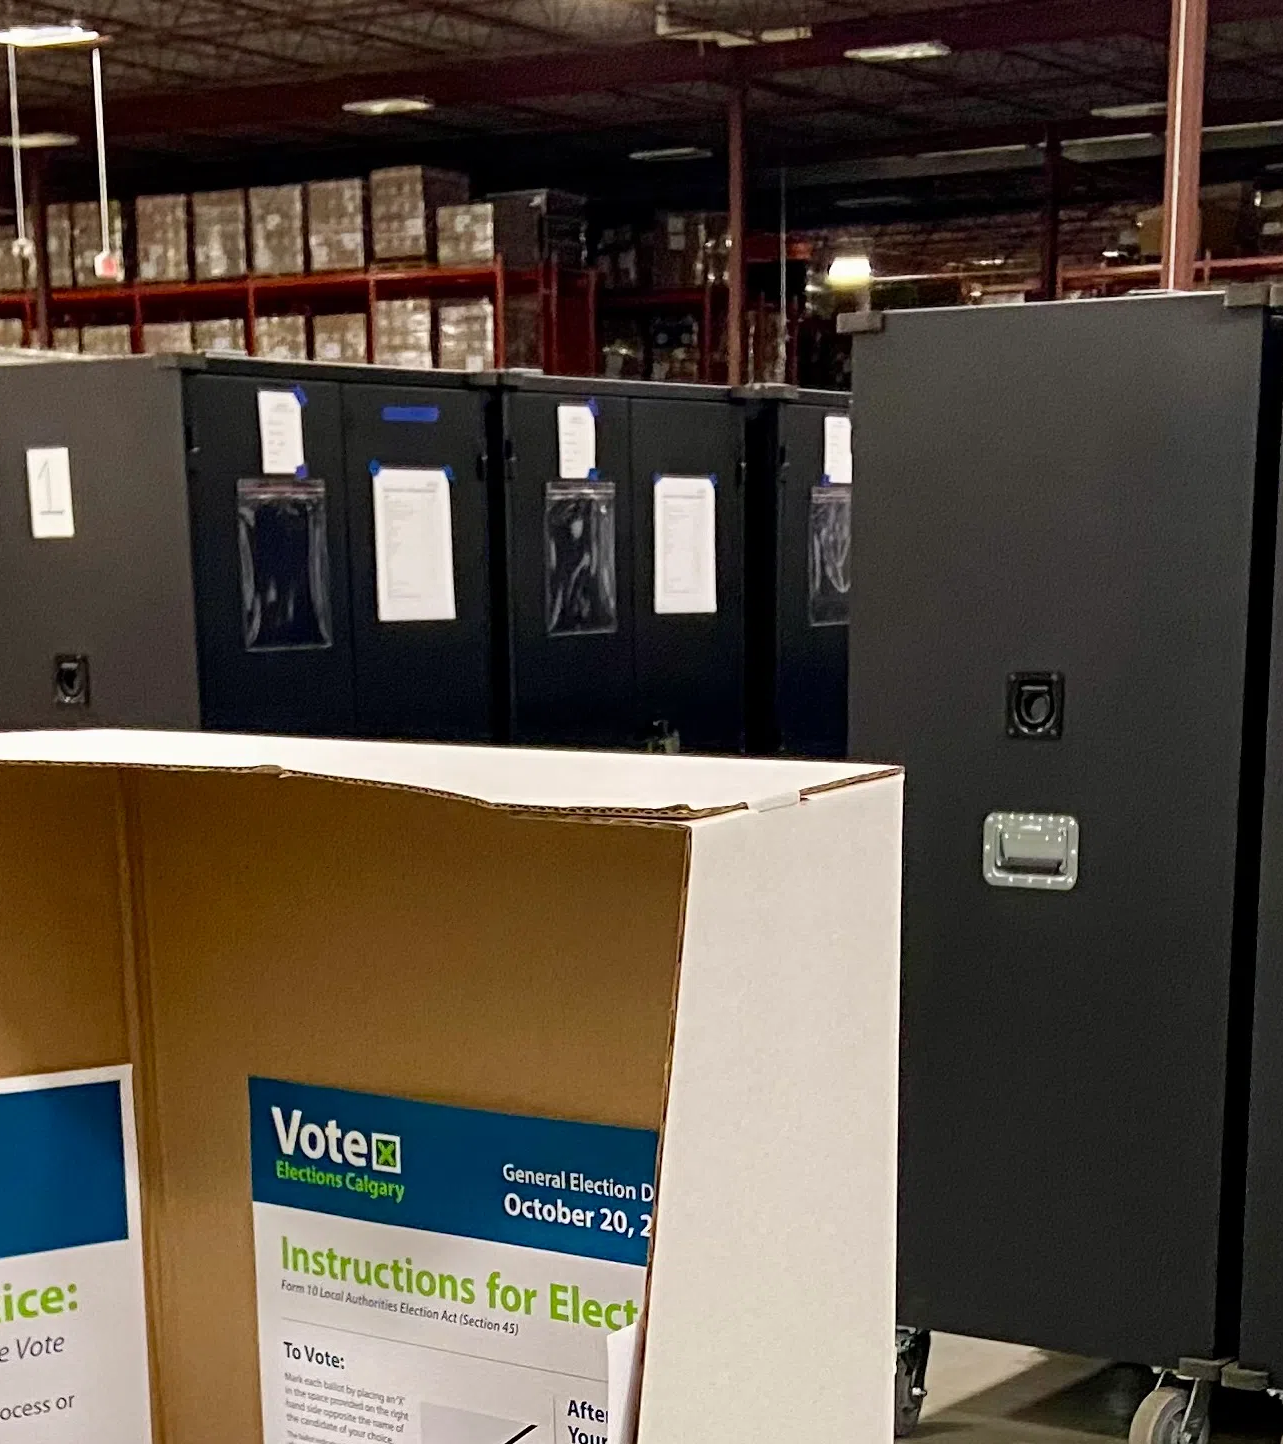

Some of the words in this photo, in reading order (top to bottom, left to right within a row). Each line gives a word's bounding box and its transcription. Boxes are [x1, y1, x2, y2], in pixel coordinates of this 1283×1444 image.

[270, 1106, 368, 1166] Vote
[275, 1160, 347, 1188] Elections
[344, 1172, 405, 1203] Calgary
[501, 1163, 566, 1189] General
[568, 1172, 637, 1200] Election
[640, 1183, 653, 1202] D
[503, 1192, 595, 1227] October
[598, 1208, 635, 1238] 20,
[639, 1214, 651, 1237] 2
[281, 1236, 476, 1304] Instructions
[485, 1271, 538, 1314] for
[549, 1283, 638, 1331] Elect
[281, 1280, 305, 1293] Form
[307, 1284, 318, 1297] 10
[320, 1286, 344, 1302] Local
[345, 1292, 398, 1313] Authorities
[400, 1302, 439, 1320] Election
[441, 1310, 458, 1324] Act
[459, 1313, 500, 1334] (Section
[500, 1321, 520, 1337] 45)
[15, 1335, 65, 1360] Vote
[282, 1341, 302, 1359] To
[302, 1345, 345, 1369] Vote:
[54, 1394, 76, 1411] or
